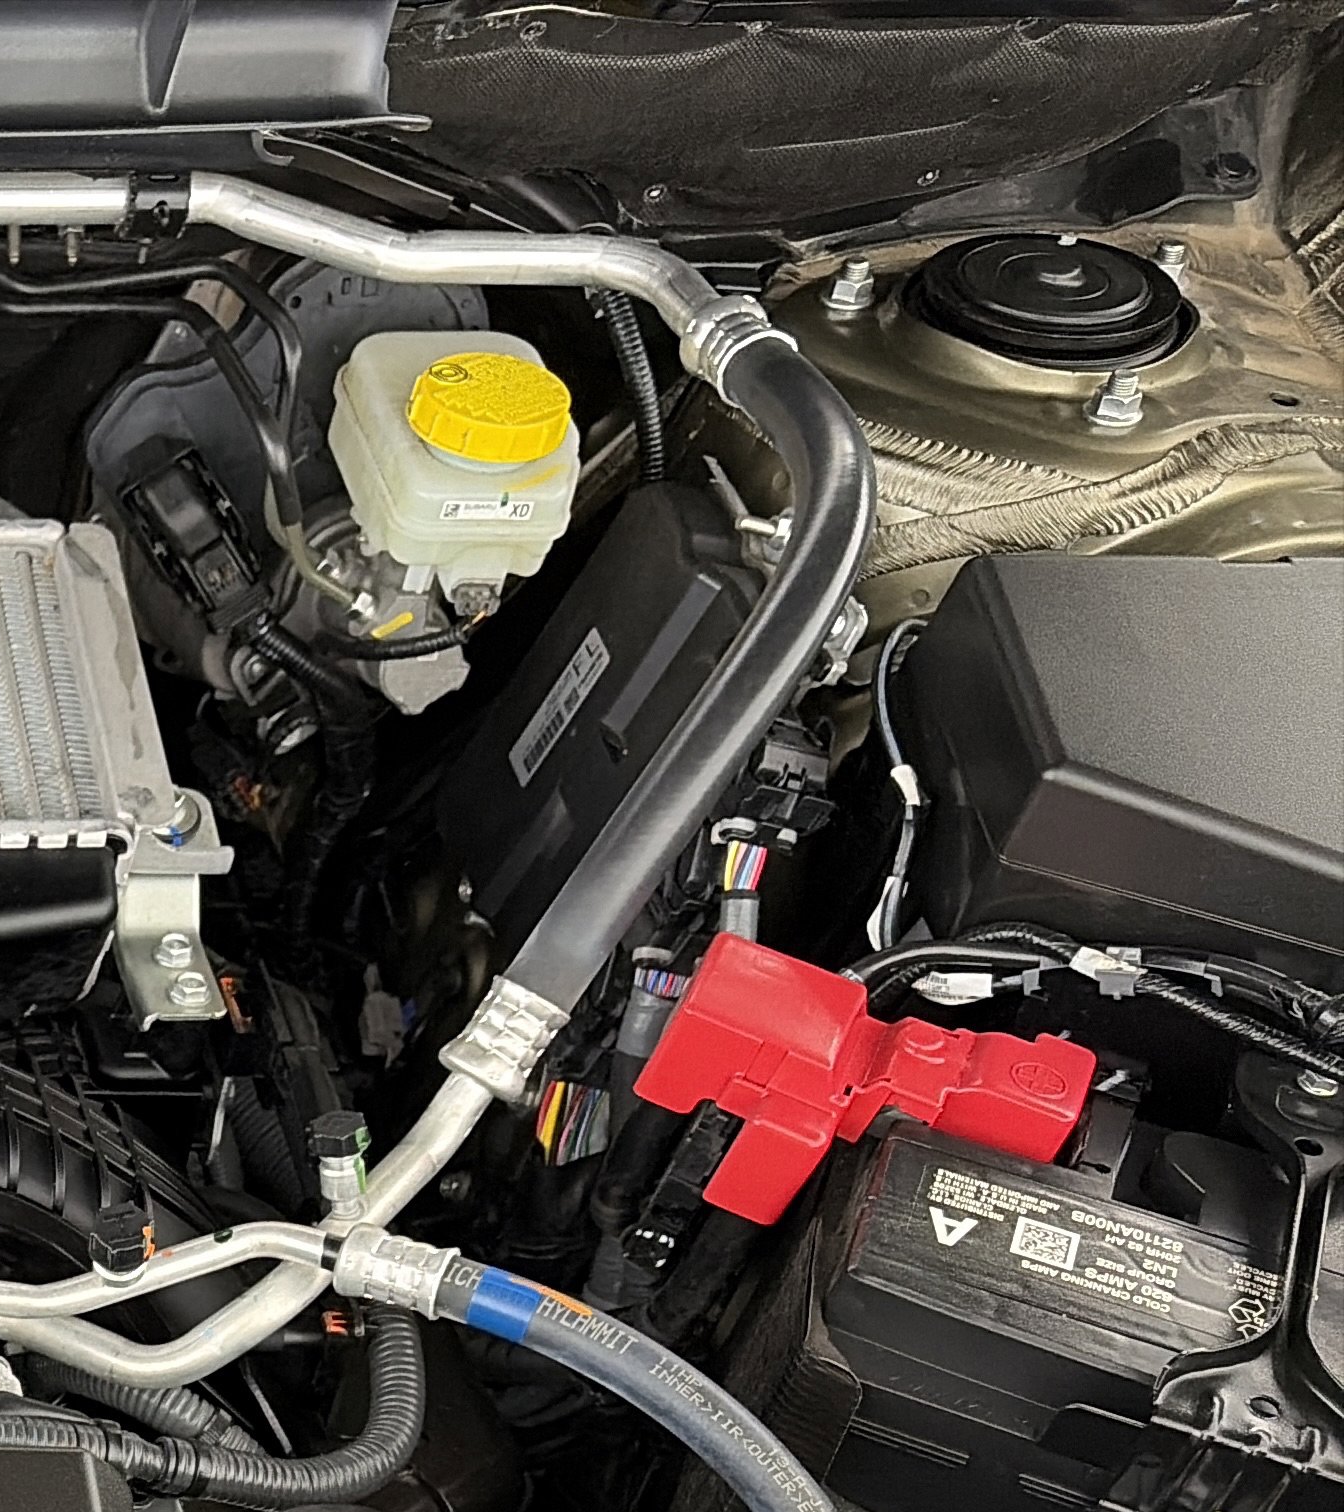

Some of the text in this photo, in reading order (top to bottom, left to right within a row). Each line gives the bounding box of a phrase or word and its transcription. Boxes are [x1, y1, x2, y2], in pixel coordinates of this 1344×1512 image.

[509, 503, 530, 517] XD
[937, 1168, 1060, 1211] AND IMPORTED MATERIALS
[953, 1181, 977, 1192] WITH
[1020, 1201, 1048, 1215] MADE
[1071, 1210, 1184, 1254] 82110AN00B
[1104, 1233, 1126, 1246] AH
[1145, 1246, 1182, 1264] 20HR
[1096, 1257, 1176, 1289] GROUP SIZE
[1142, 1258, 1178, 1279] LN2
[1021, 1259, 1170, 1313] COLD CRANKING AMPS
[1084, 1267, 1174, 1303] 620 AMPS
